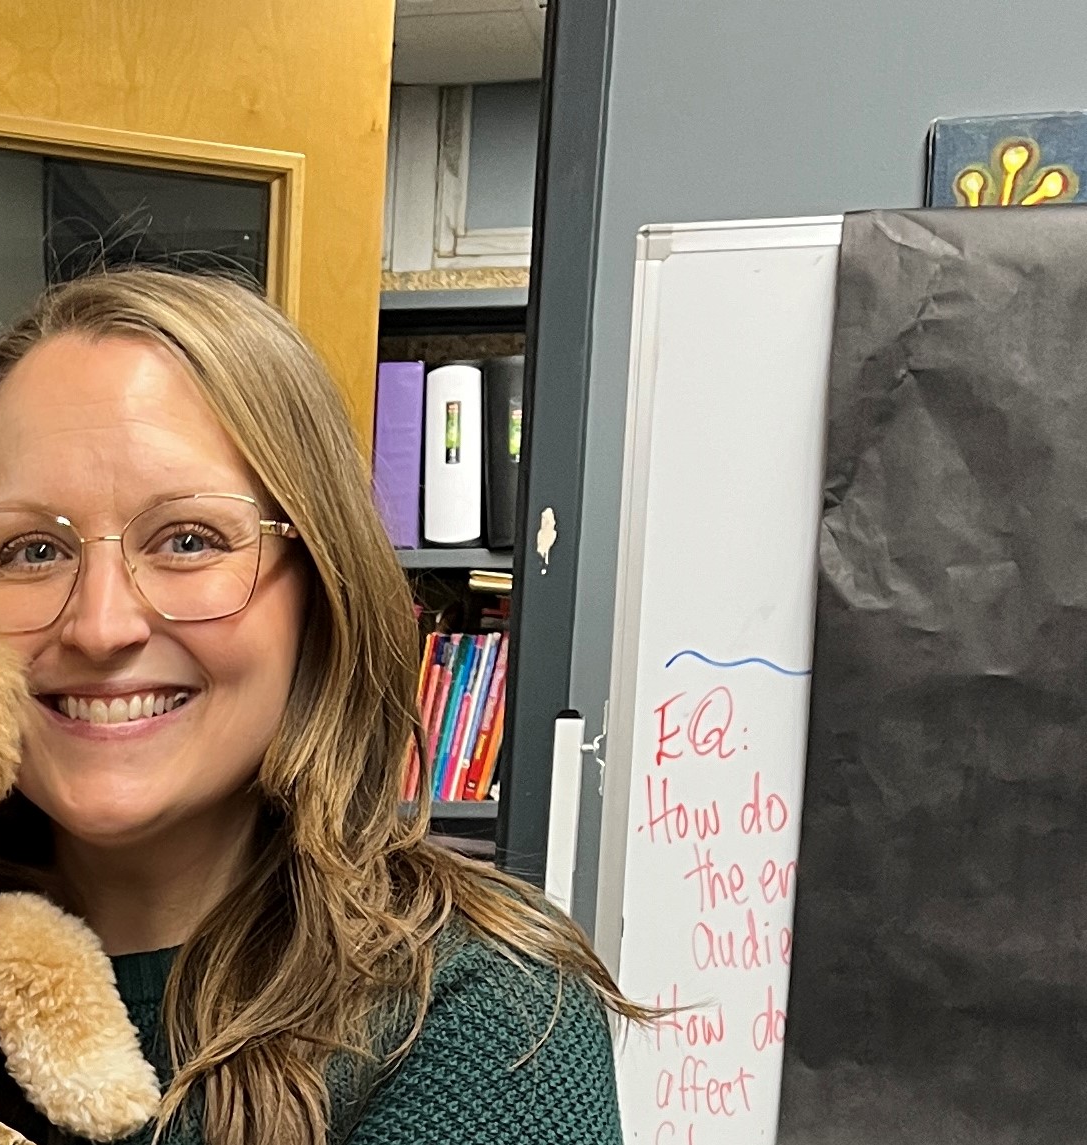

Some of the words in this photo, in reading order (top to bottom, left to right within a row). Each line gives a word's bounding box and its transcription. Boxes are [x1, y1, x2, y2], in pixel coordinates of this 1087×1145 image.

[653, 686, 749, 766] EQ:
[646, 774, 720, 844] How
[741, 771, 788, 834] do
[683, 843, 749, 912] the
[651, 984, 724, 1051] How
[752, 985, 787, 1051] do
[656, 1055, 755, 1116] affect
